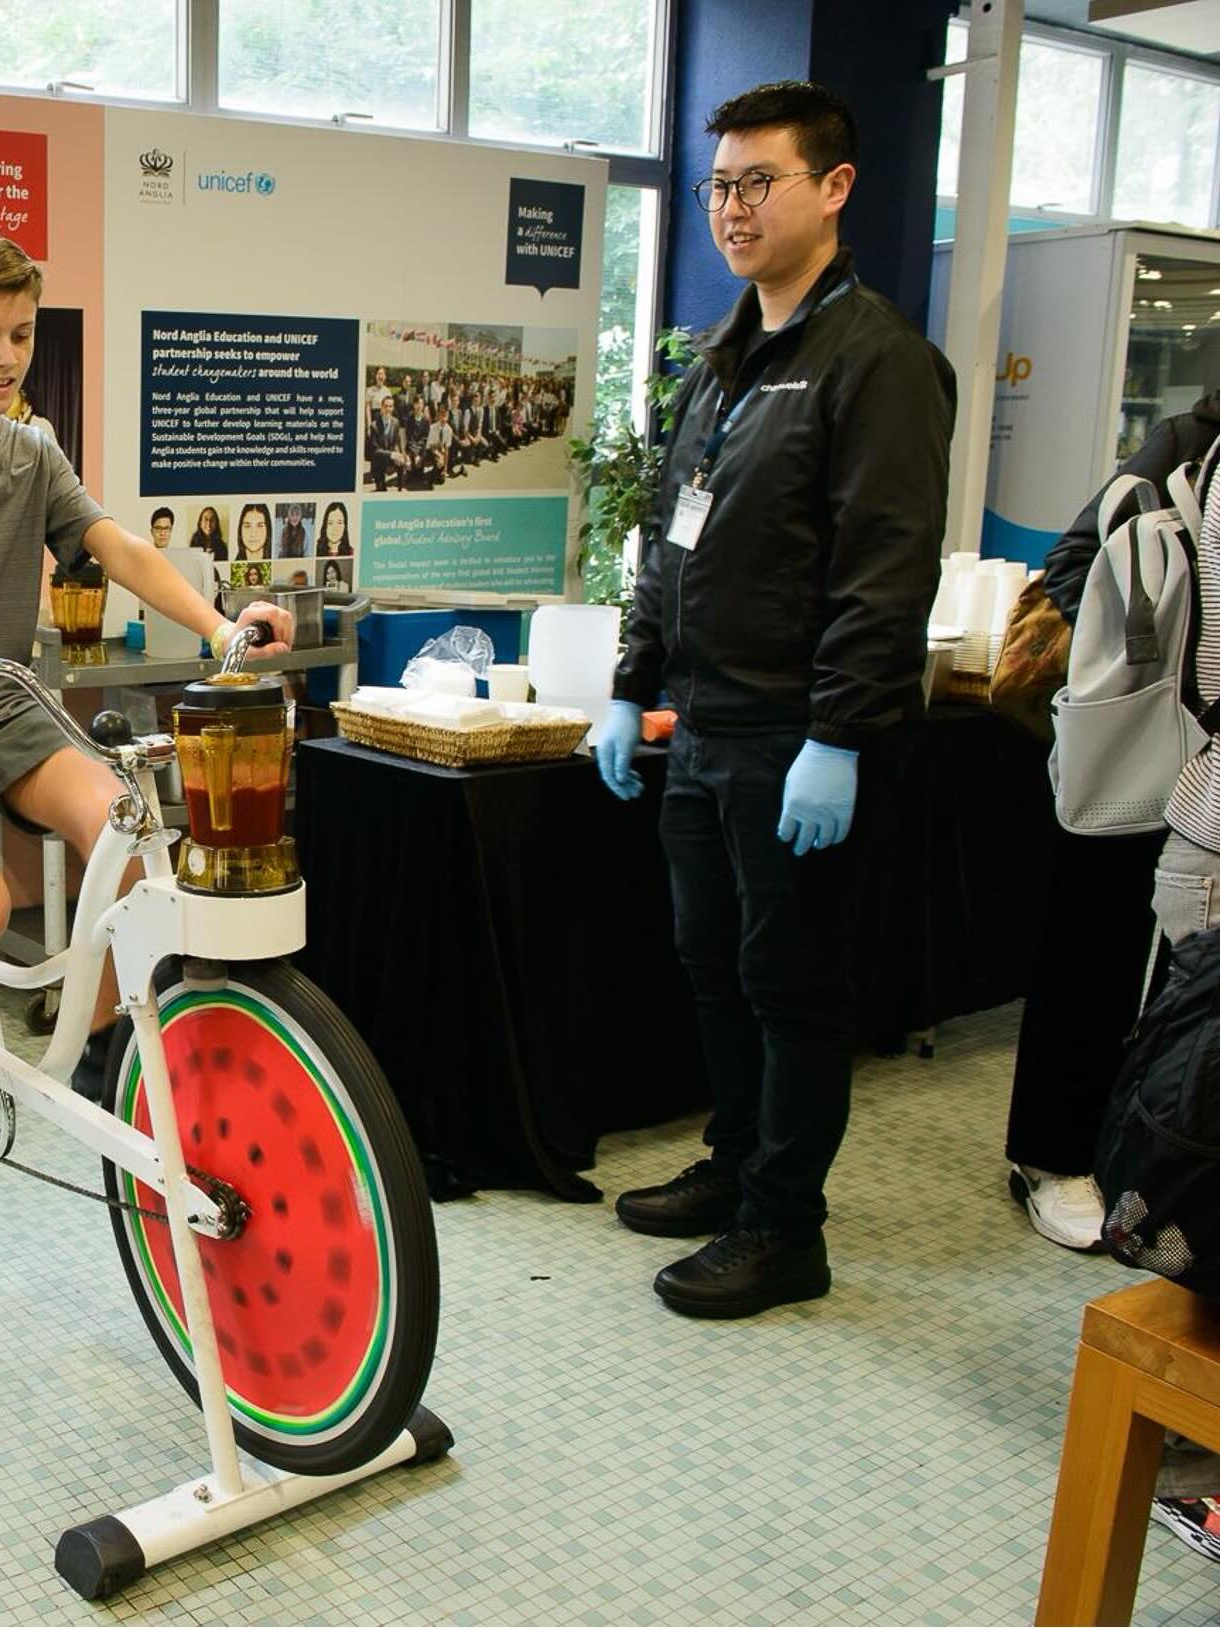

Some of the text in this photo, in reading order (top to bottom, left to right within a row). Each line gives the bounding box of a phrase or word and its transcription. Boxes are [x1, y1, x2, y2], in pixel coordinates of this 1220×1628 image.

[142, 181, 169, 190] NORD
[198, 170, 252, 192] unicef
[6, 184, 29, 200] the
[518, 206, 554, 224] Making
[517, 225, 567, 241] a difference
[516, 242, 575, 258] with UNICEF
[153, 329, 318, 345] Nord Anglia Education and UNICEF
[152, 347, 300, 363] partnership seeks to empower
[152, 364, 339, 384] student changemakers around the world
[152, 392, 171, 401] Nord
[177, 392, 200, 403] Anglia
[205, 392, 241, 401] Education
[247, 393, 260, 402] and
[265, 393, 292, 402] UNICEF
[296, 393, 313, 401] have
[328, 396, 344, 404] new,
[152, 406, 344, 417] three-year global partnership that will help support
